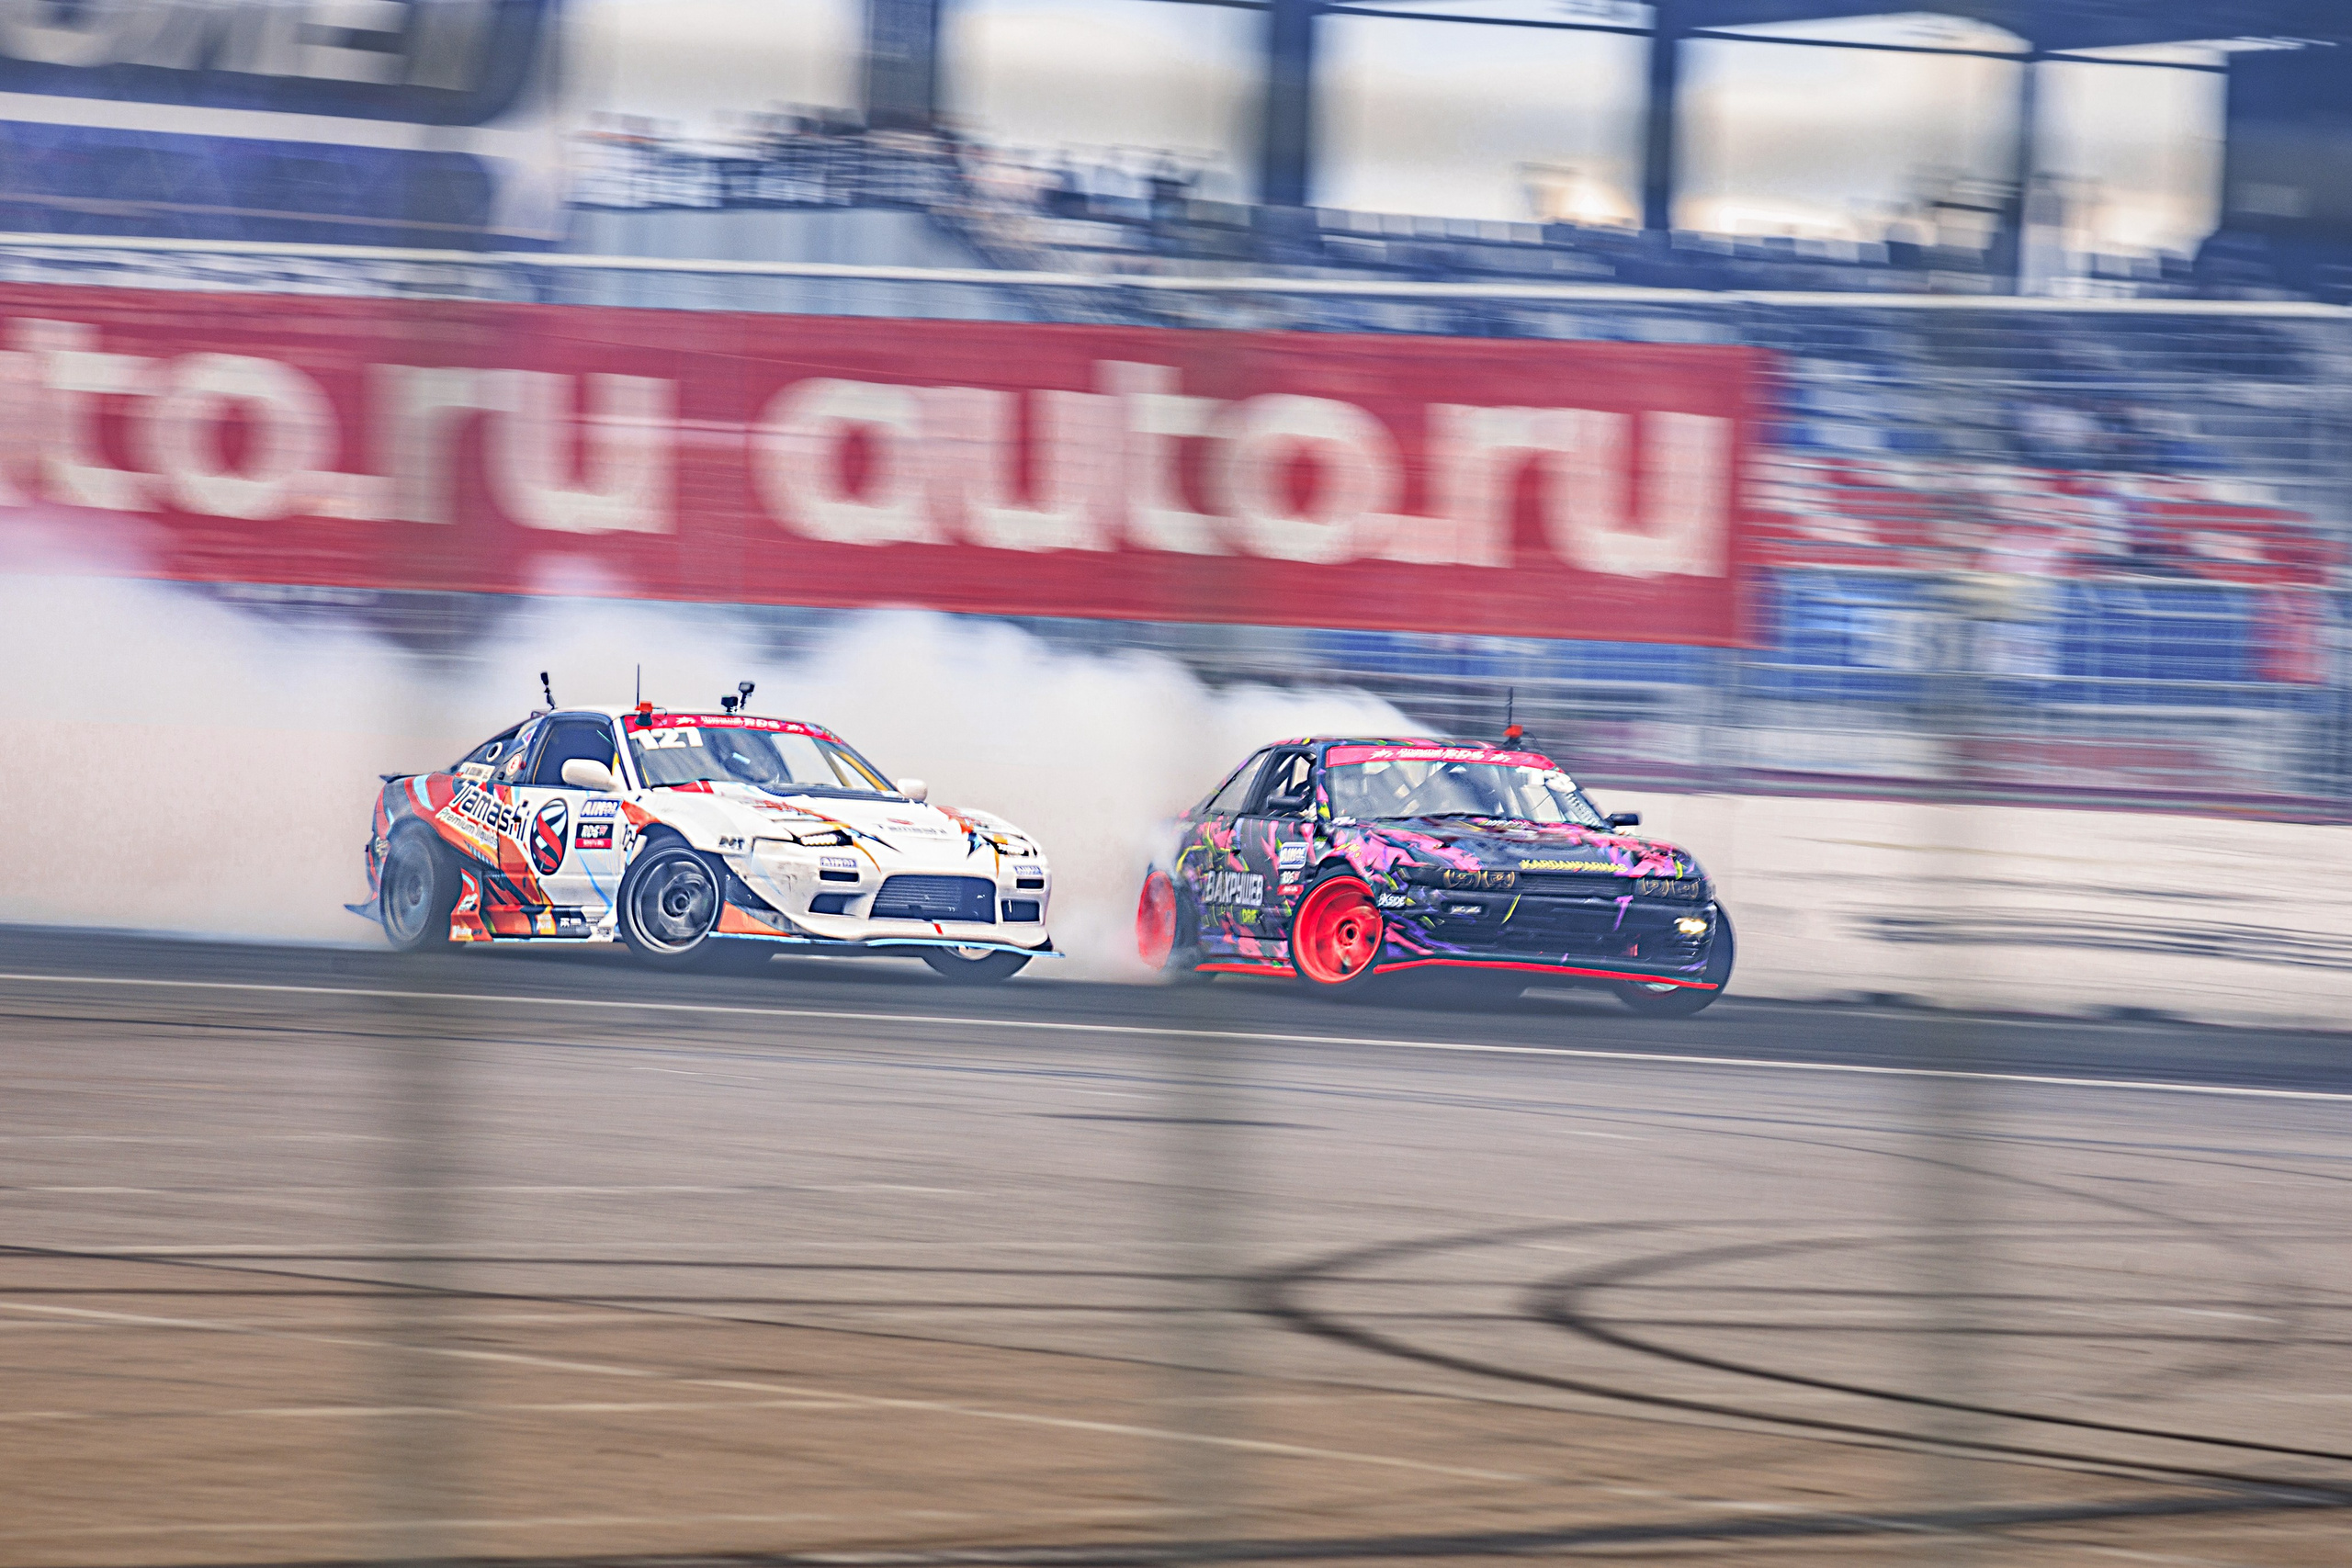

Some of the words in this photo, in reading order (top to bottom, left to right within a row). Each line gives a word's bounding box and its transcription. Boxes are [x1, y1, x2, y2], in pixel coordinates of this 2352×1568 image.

[749, 357, 1734, 579] auto.ru
[743, 717, 781, 729] RDS
[628, 727, 675, 750] 121
[439, 807, 475, 834] Premium
